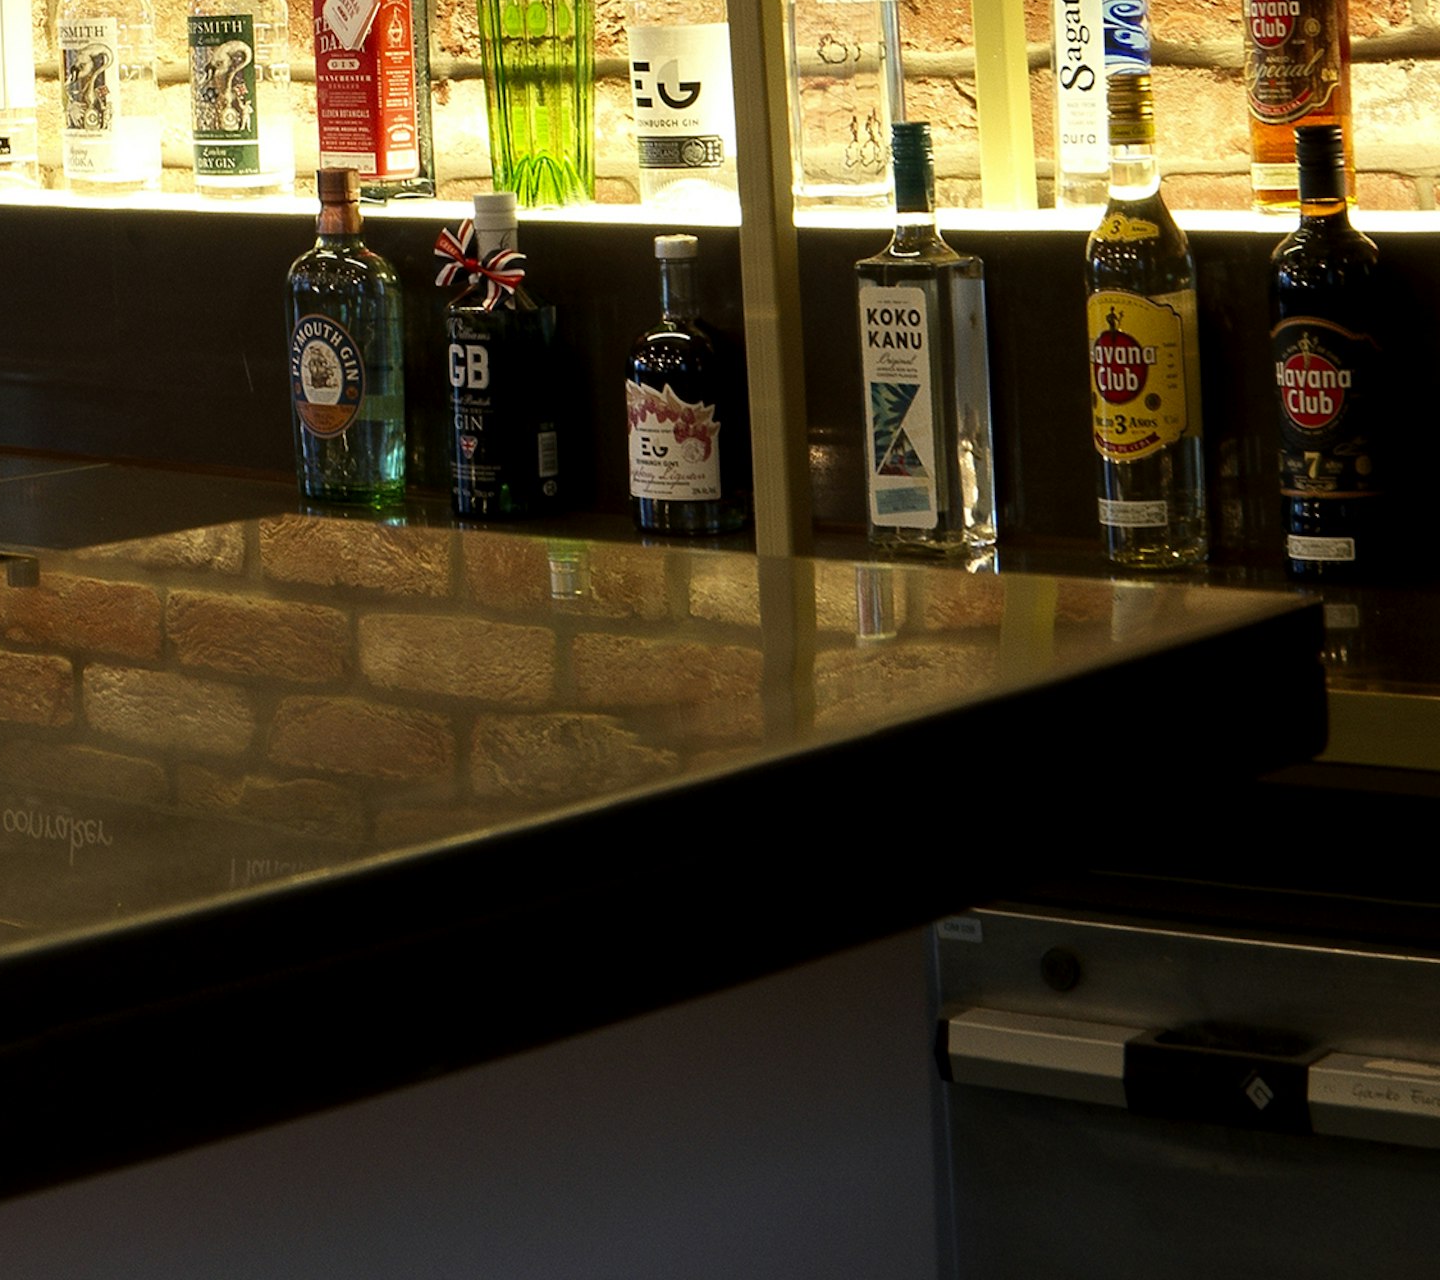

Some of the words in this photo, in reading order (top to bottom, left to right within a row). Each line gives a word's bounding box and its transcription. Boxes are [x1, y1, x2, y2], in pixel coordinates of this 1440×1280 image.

[60, 24, 105, 38] PSMITH
[1252, 19, 1287, 38] Club
[331, 61, 356, 69] GIN
[319, 74, 372, 82] MANCHESTER
[633, 59, 701, 109] EG
[682, 119, 699, 127] GIN
[197, 158, 216, 169] DRY
[216, 158, 236, 168] GIN
[1111, 220, 1121, 234] 3
[866, 308, 921, 326] KOKO
[868, 330, 922, 350] KANU
[292, 322, 343, 377] PLYMOUTH
[339, 348, 360, 382] GIN
[448, 343, 490, 390] GB
[1276, 361, 1351, 388] Havana
[1098, 366, 1139, 391] Club
[1287, 389, 1333, 415] Club
[454, 414, 484, 431] GIN
[1114, 414, 1128, 434] 3
[641, 437, 668, 457] EG
[1304, 451, 1322, 479] 7
